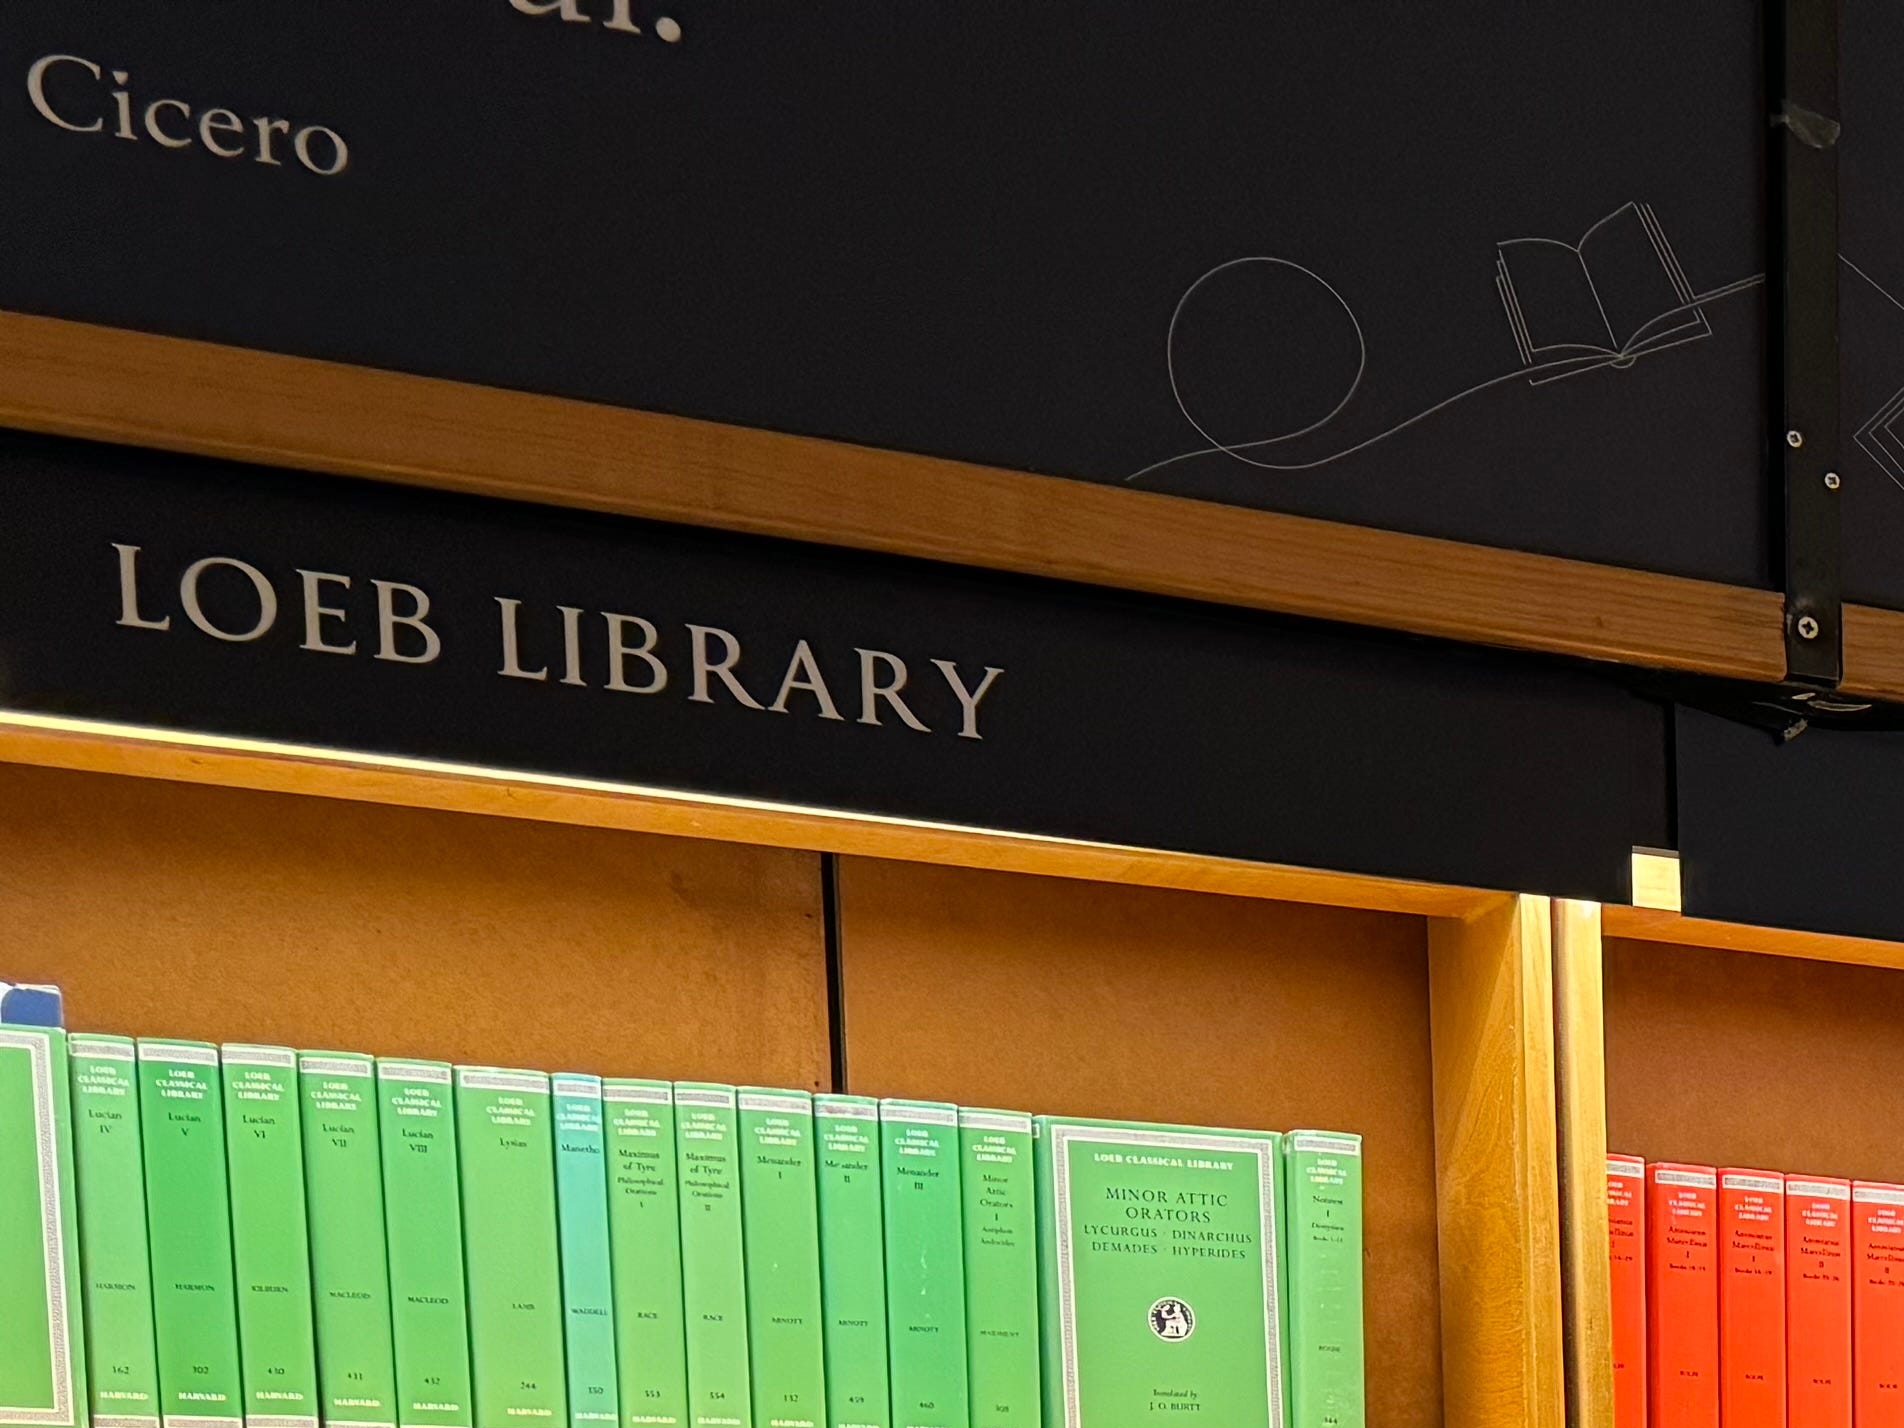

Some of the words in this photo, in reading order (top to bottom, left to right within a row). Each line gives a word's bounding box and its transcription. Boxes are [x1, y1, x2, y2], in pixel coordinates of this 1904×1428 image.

[27, 55, 348, 175] Cicero
[112, 543, 440, 663] LOEB
[494, 597, 1004, 739] LIBRARY
[88, 1109, 122, 1120] Lucian
[168, 1112, 201, 1123] Lucian
[242, 1115, 275, 1125] Lucian
[100, 1125, 111, 1134] IV
[181, 1128, 189, 1137] V
[322, 1123, 354, 1134] Lucian
[401, 1128, 433, 1139] Lucian
[254, 1130, 266, 1139] VI
[1094, 1153, 1122, 1163] LOEB
[1125, 1155, 1183, 1168] CLASSICAL
[1187, 1159, 1233, 1171] LIBRARY
[1106, 1187, 1167, 1203] MINOR
[1176, 1192, 1228, 1207] ATTIC
[1125, 1206, 1211, 1223] ORATORS
[1084, 1224, 1157, 1238] LYCURGUS
[1172, 1229, 1252, 1243] DINARCHUS
[1092, 1241, 1157, 1254] DEMADES
[1172, 1246, 1246, 1259] HYPERIDES
[100, 1391, 148, 1400] HARVARD
[178, 1392, 226, 1401] HARVARD
[256, 1391, 303, 1401] HARVARD
